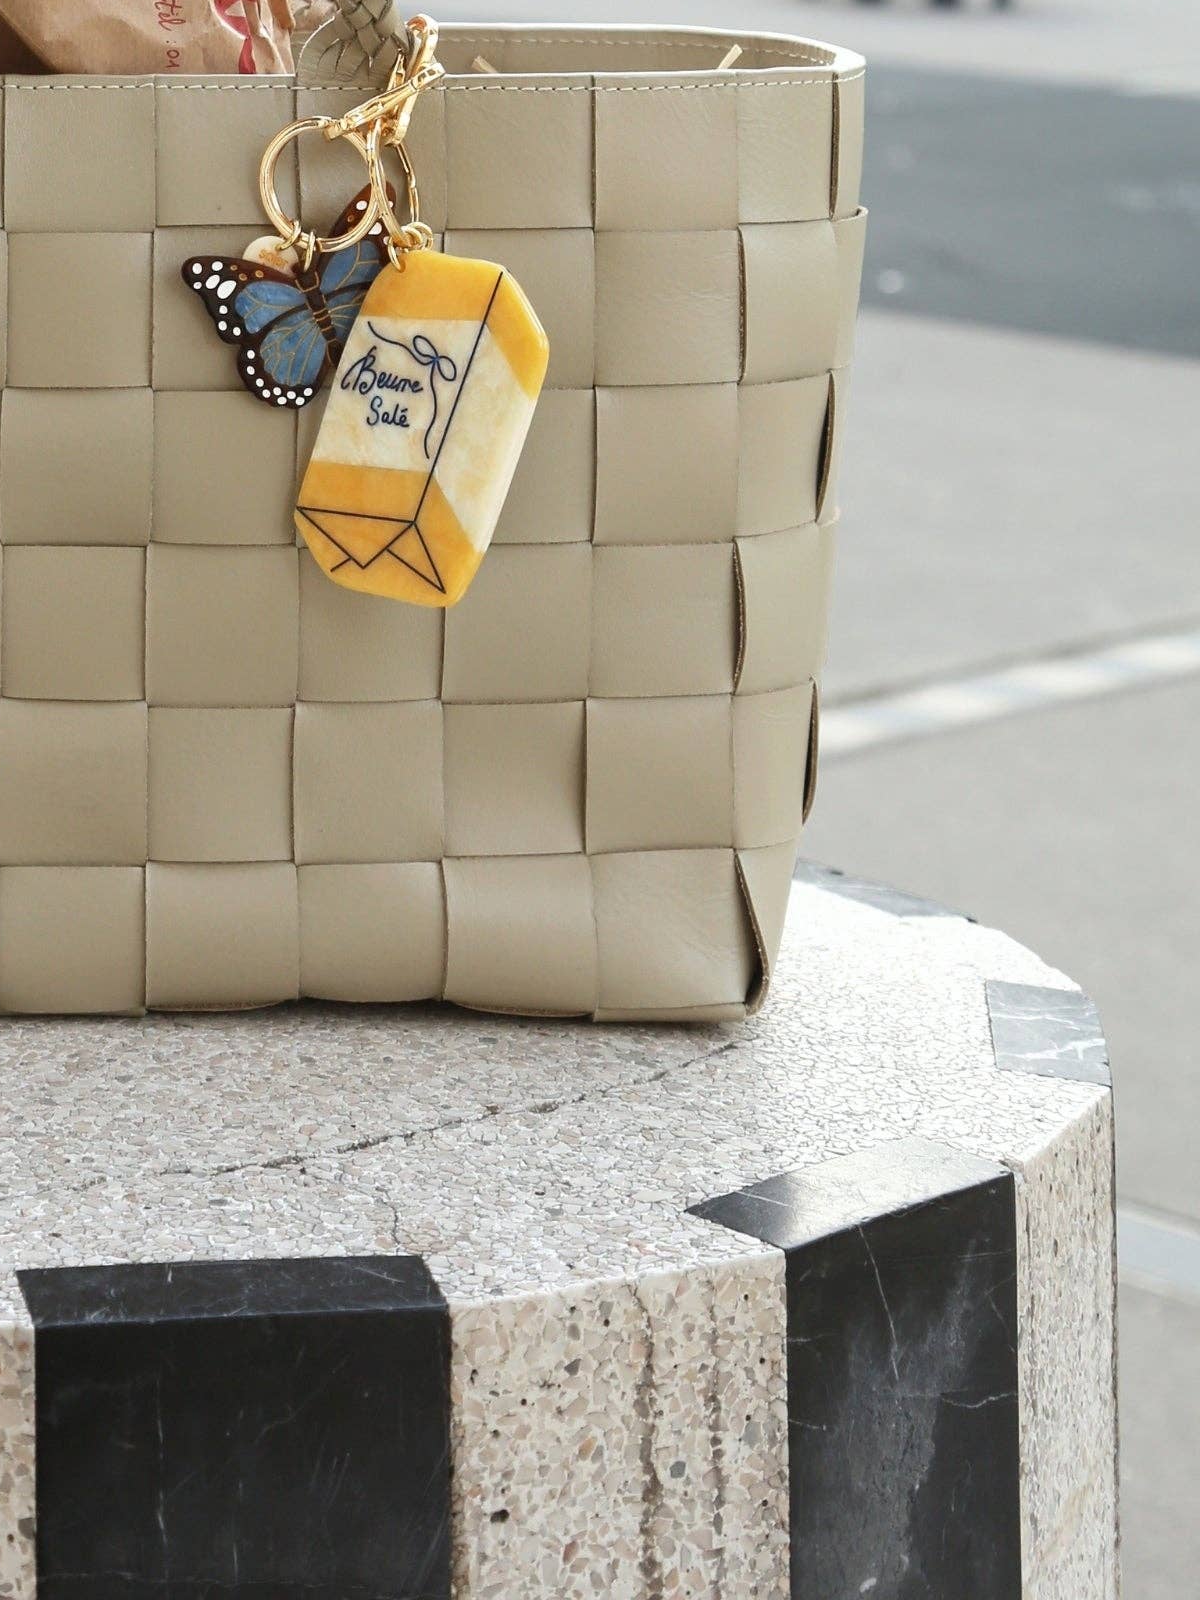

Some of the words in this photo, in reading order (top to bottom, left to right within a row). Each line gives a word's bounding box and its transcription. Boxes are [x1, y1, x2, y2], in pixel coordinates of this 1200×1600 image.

[166, 48, 180, 68] 01
[341, 346, 424, 395] Beurre
[366, 396, 409, 427] Salé
